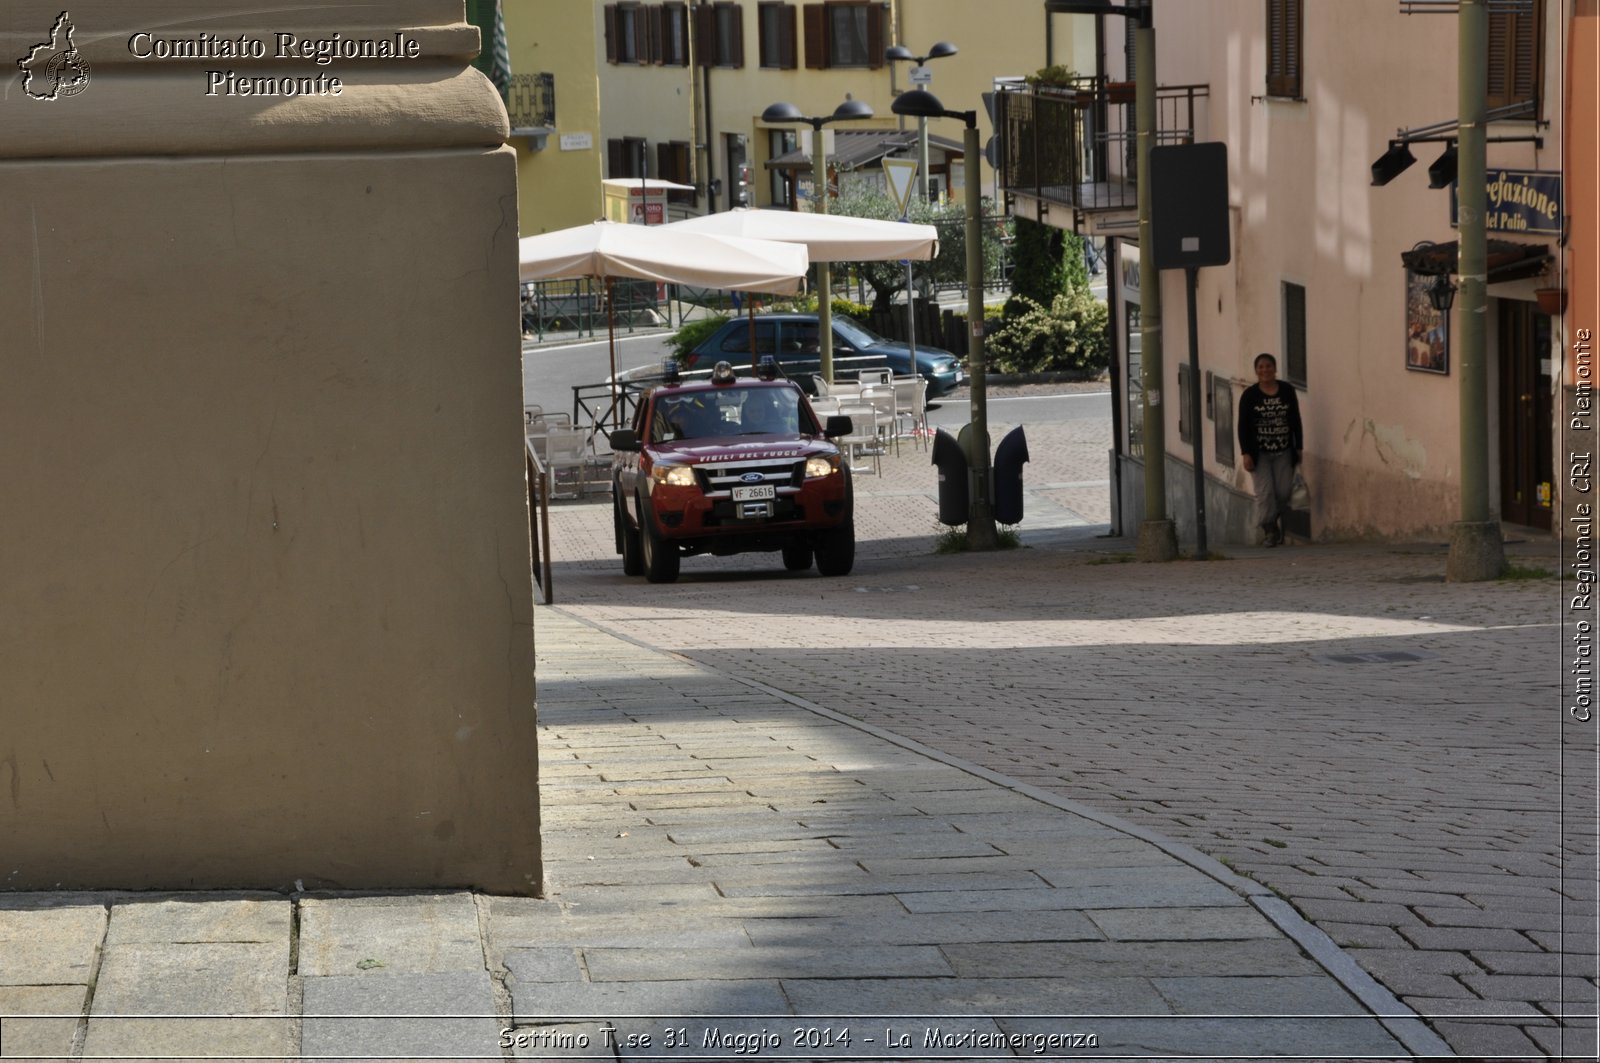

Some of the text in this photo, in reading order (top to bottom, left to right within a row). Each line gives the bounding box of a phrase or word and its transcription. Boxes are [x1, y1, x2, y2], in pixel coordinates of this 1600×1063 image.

[1501, 212, 1527, 230] Palio
[700, 454, 734, 462] VIGILI
[734, 486, 774, 498] VF 26616
